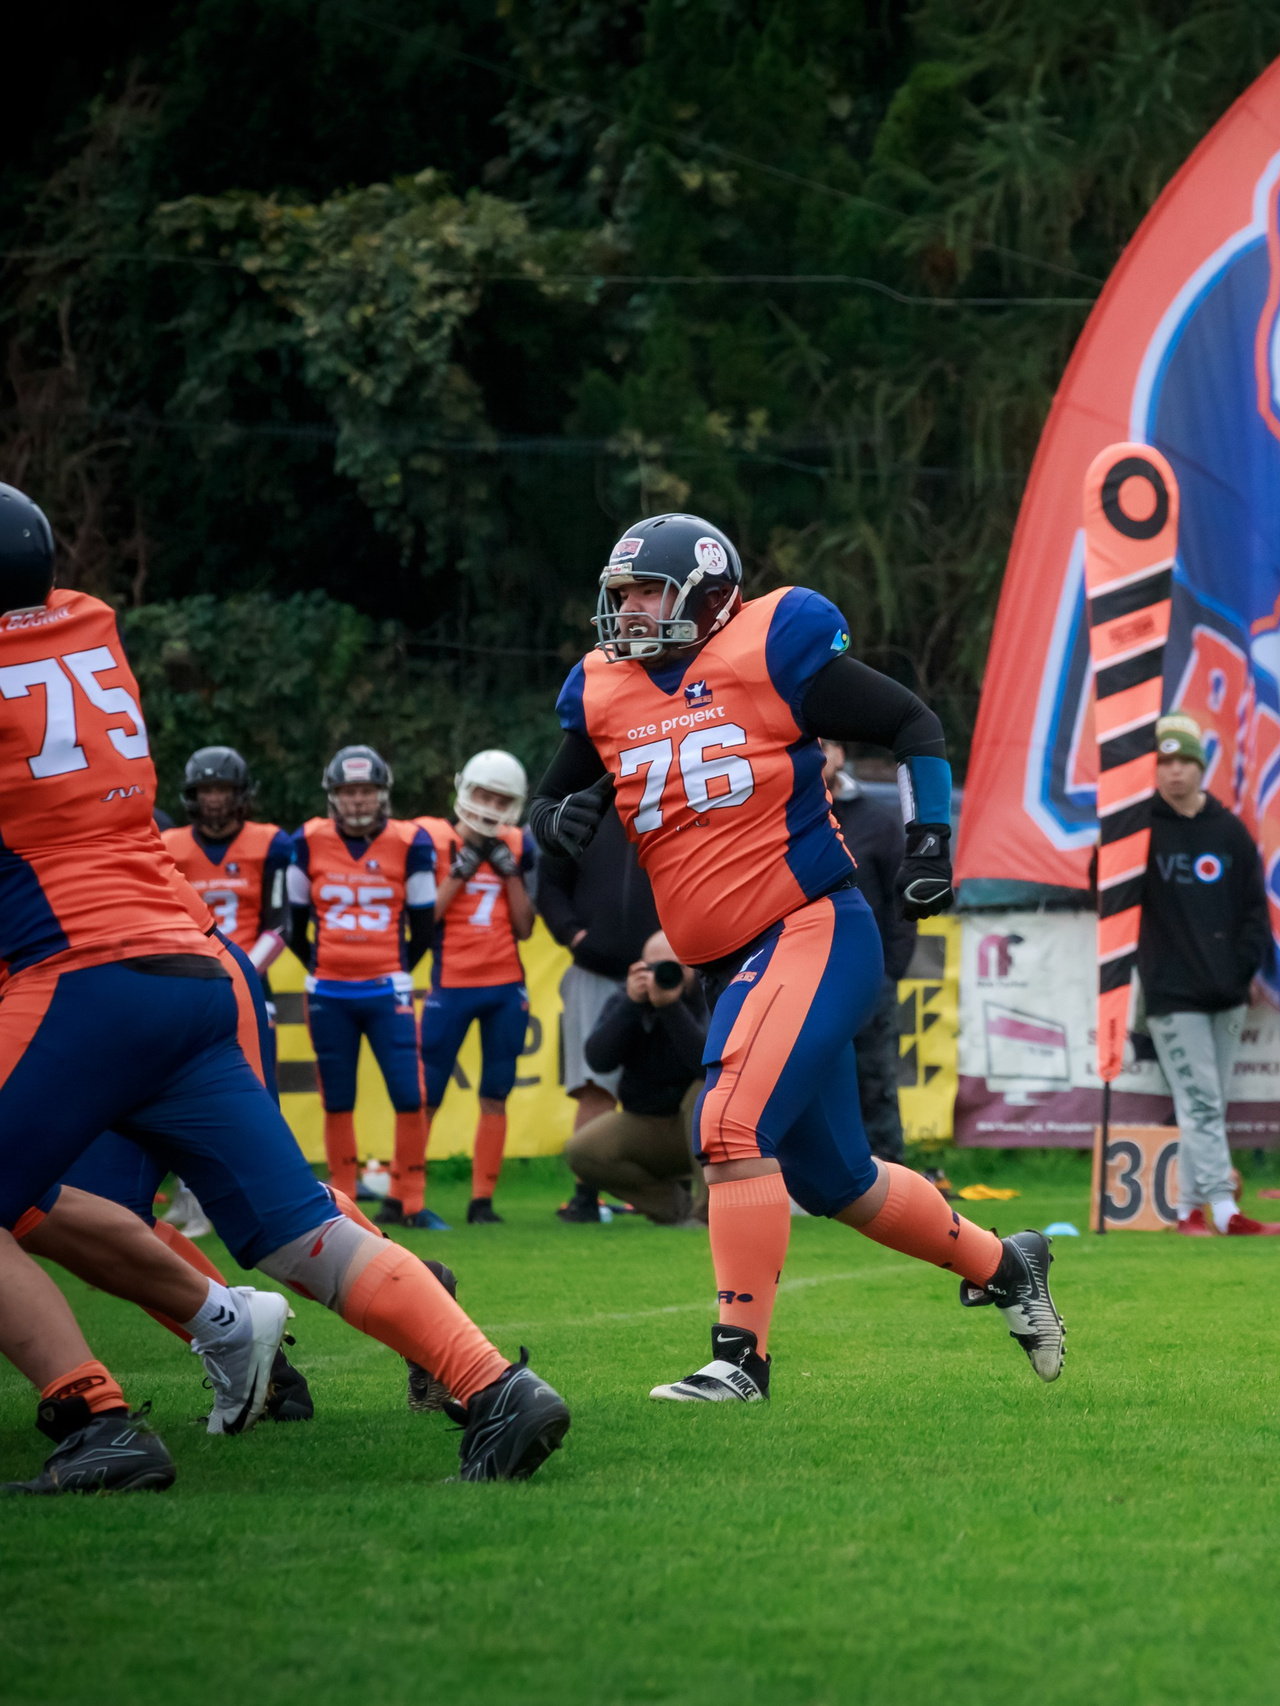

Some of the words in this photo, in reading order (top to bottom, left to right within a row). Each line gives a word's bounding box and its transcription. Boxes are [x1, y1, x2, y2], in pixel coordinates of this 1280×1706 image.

[0, 644, 150, 780] 75
[627, 724, 657, 740] oze
[661, 706, 725, 735] projekt
[619, 722, 755, 835] 76
[320, 884, 394, 931] 25
[465, 882, 502, 927] 7
[1103, 1140, 1180, 1222] 30
[726, 1370, 758, 1400] NIKE
